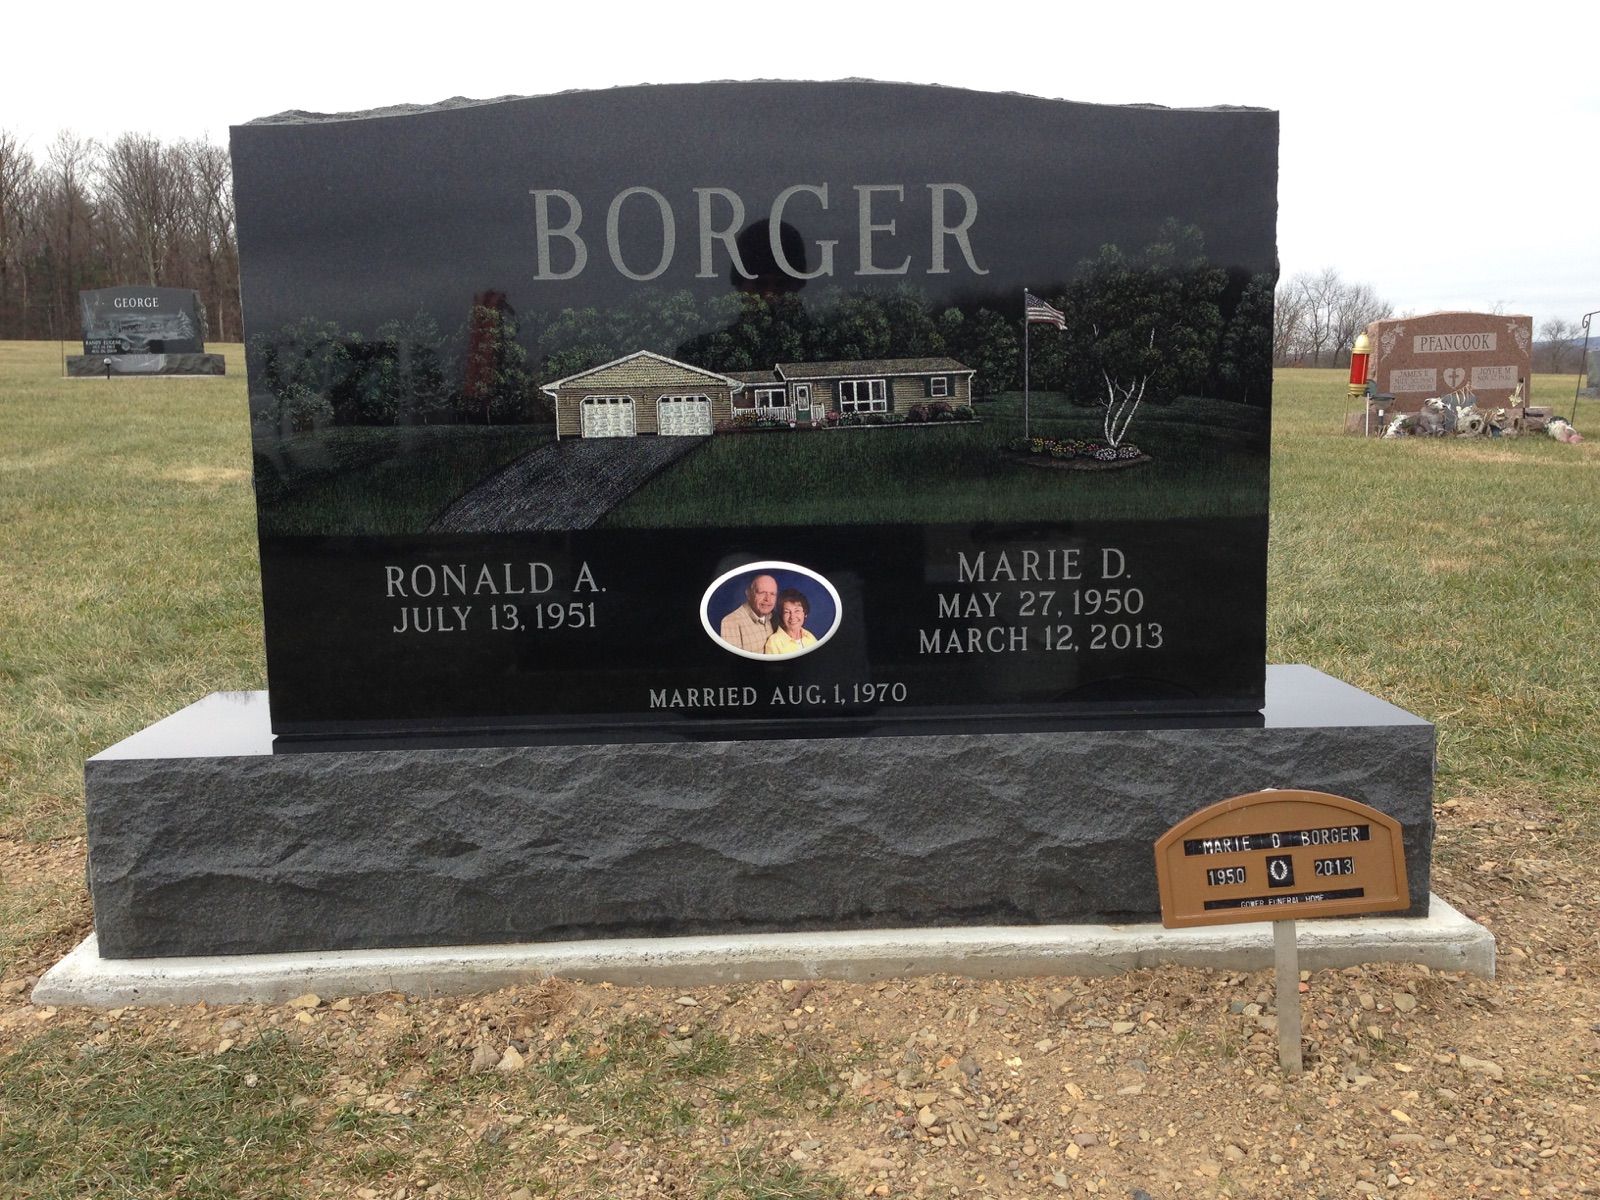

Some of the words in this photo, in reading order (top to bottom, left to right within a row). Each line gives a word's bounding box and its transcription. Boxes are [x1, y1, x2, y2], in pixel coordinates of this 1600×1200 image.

[528, 182, 990, 282] BORGER
[114, 297, 160, 308] GEORGE
[1420, 334, 1490, 351] PFANCOOK
[385, 562, 553, 598] RONALD
[573, 561, 607, 593] A.
[957, 549, 1082, 583] MARIE
[1101, 548, 1132, 579] D.
[393, 606, 472, 633] JULY
[490, 604, 526, 632] 13,
[535, 602, 596, 630] 1951
[938, 592, 1002, 619] MAY
[1019, 590, 1063, 618] 27,
[1073, 588, 1145, 616] 1950
[919, 626, 1028, 654] MARCH
[1044, 624, 1080, 653] 12,
[1089, 622, 1164, 650] 2013
[650, 686, 757, 709] MARRIED
[770, 684, 826, 706] AUG.
[834, 683, 846, 705] 1,
[853, 682, 908, 704] 1970
[1202, 836, 1252, 856] MARIE
[1271, 833, 1281, 849] D
[1301, 826, 1361, 846] BORGER
[1208, 867, 1246, 887] 1950
[1315, 857, 1353, 877] 2013
[1268, 896, 1299, 906] FUNERAL
[1305, 894, 1325, 903] HOME
